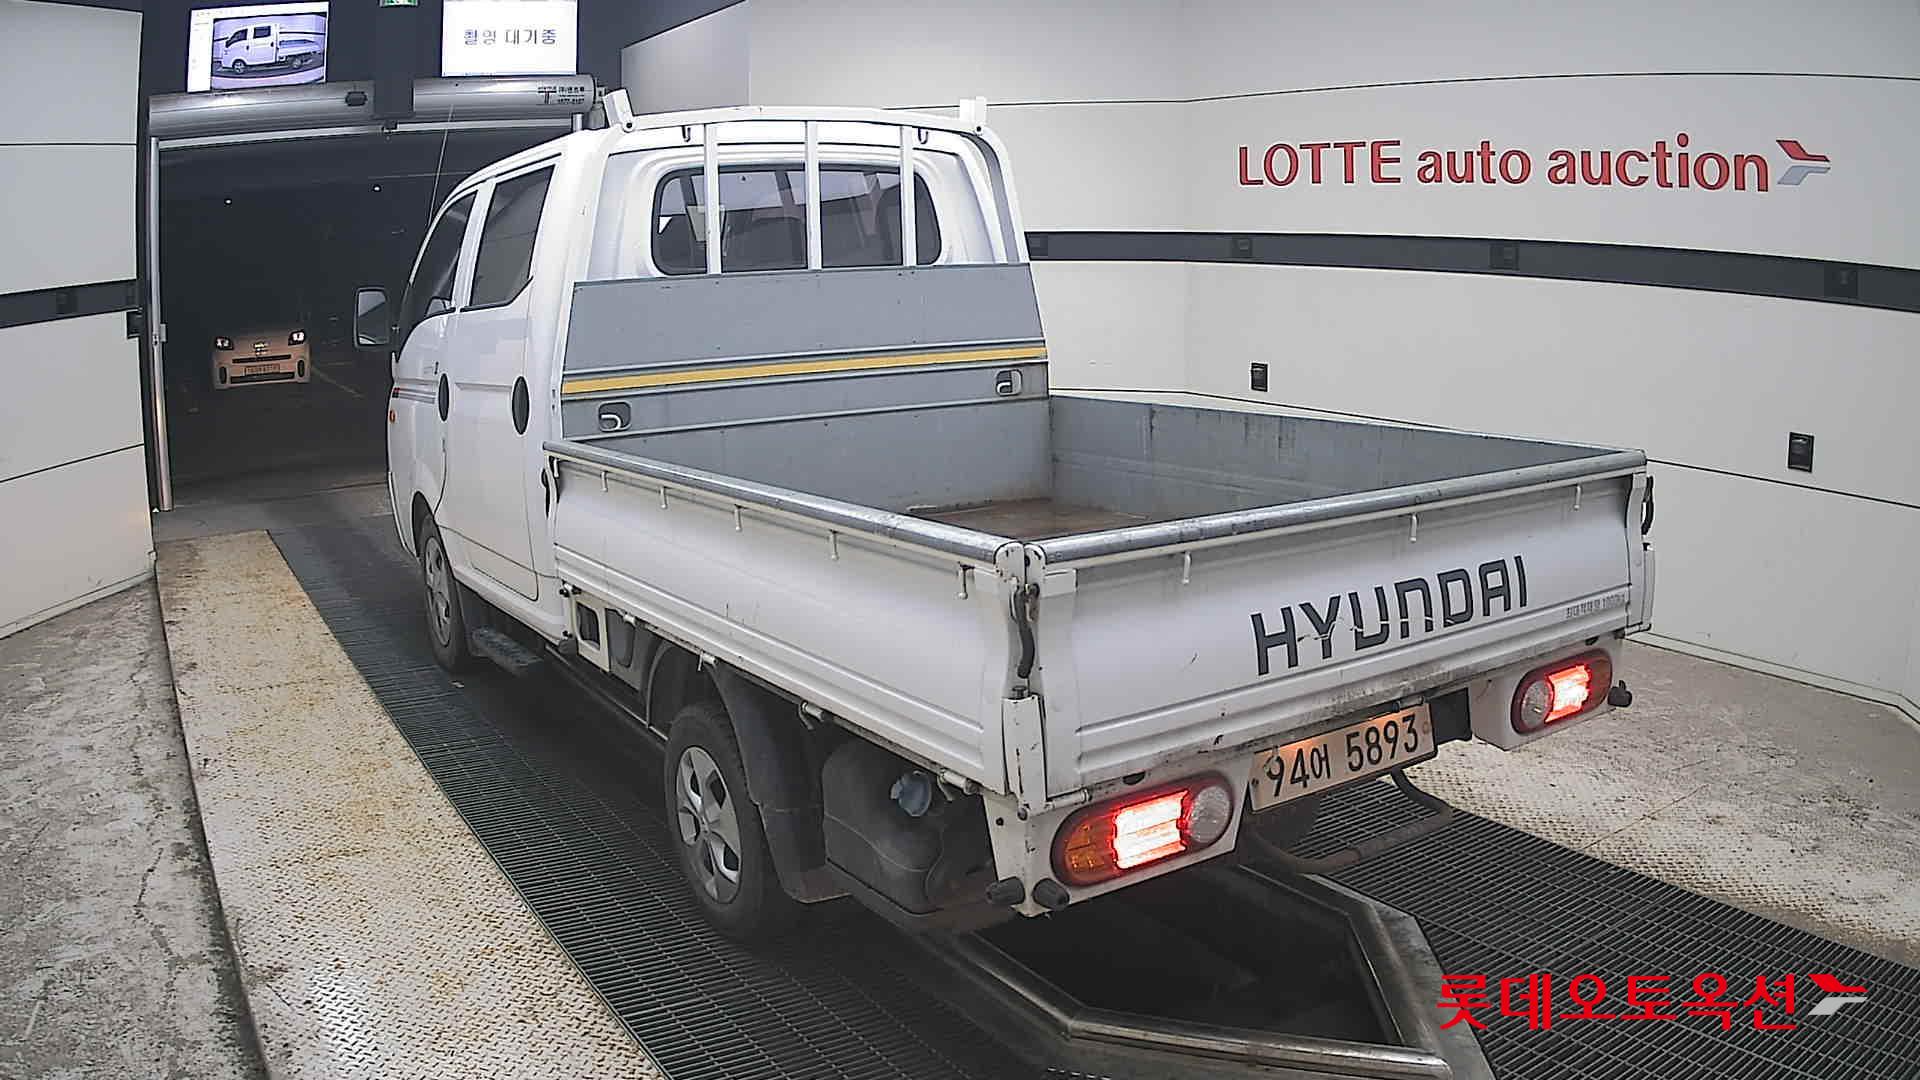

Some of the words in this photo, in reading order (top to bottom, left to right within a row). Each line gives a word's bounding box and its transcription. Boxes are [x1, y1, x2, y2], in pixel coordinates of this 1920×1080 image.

[504, 28, 557, 45] 대기중
[1239, 140, 1401, 187] LOTTE
[1416, 140, 1531, 185] auto
[1547, 133, 1770, 193] auction
[1250, 555, 1528, 676] HYUNDAI
[1264, 742, 1331, 798] 94어
[1345, 713, 1420, 773] 5893
